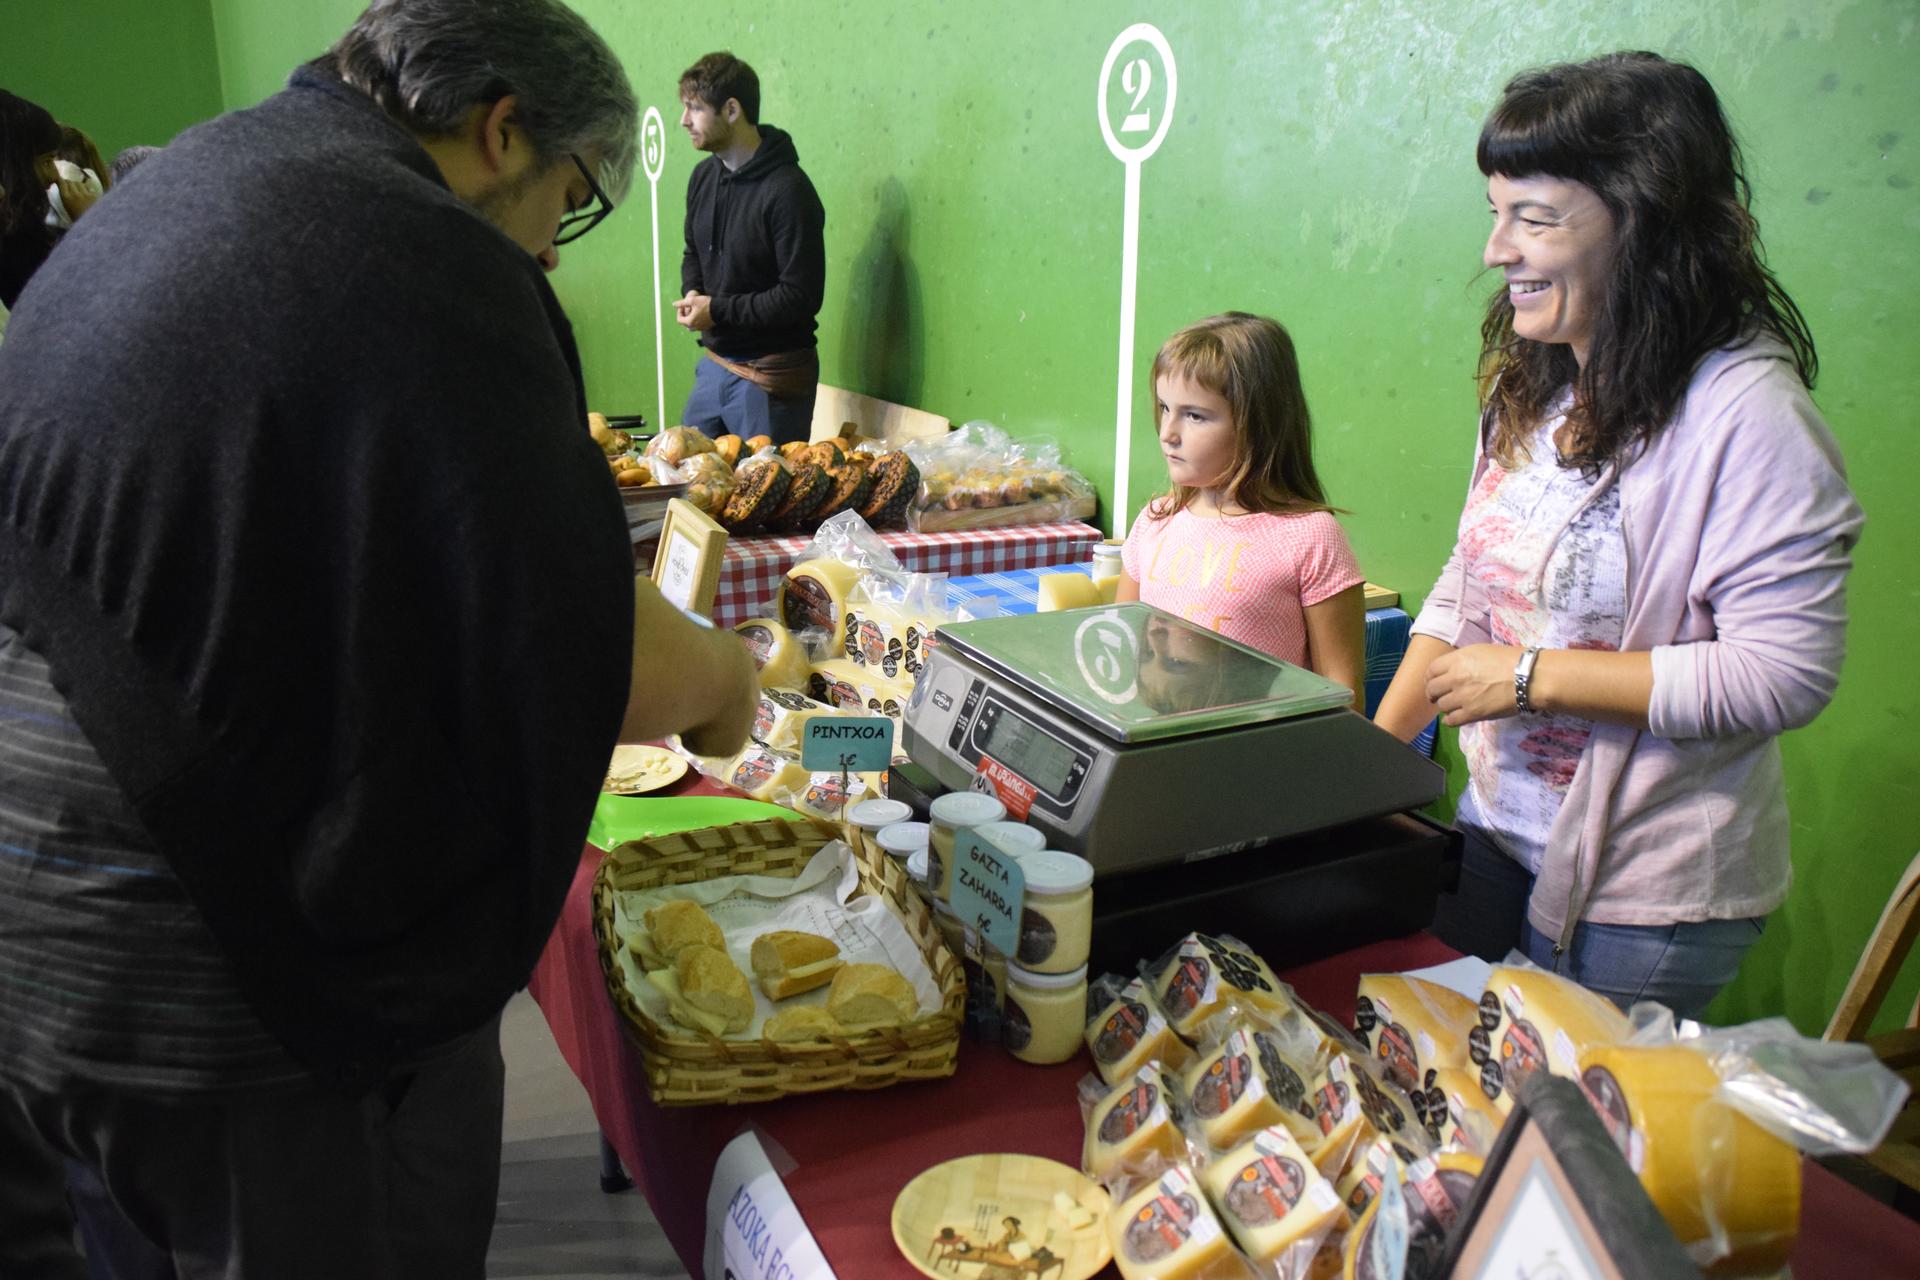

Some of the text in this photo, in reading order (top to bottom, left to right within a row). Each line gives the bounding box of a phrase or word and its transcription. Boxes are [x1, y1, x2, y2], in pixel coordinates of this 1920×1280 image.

[1120, 59, 1152, 132] 2
[1148, 536, 1252, 593] LOVE
[812, 725, 885, 739] PINTXOA
[970, 845, 1009, 886] GAZTA
[959, 867, 1013, 921] ZAHARRA
[728, 1183, 771, 1271] AZOKA
